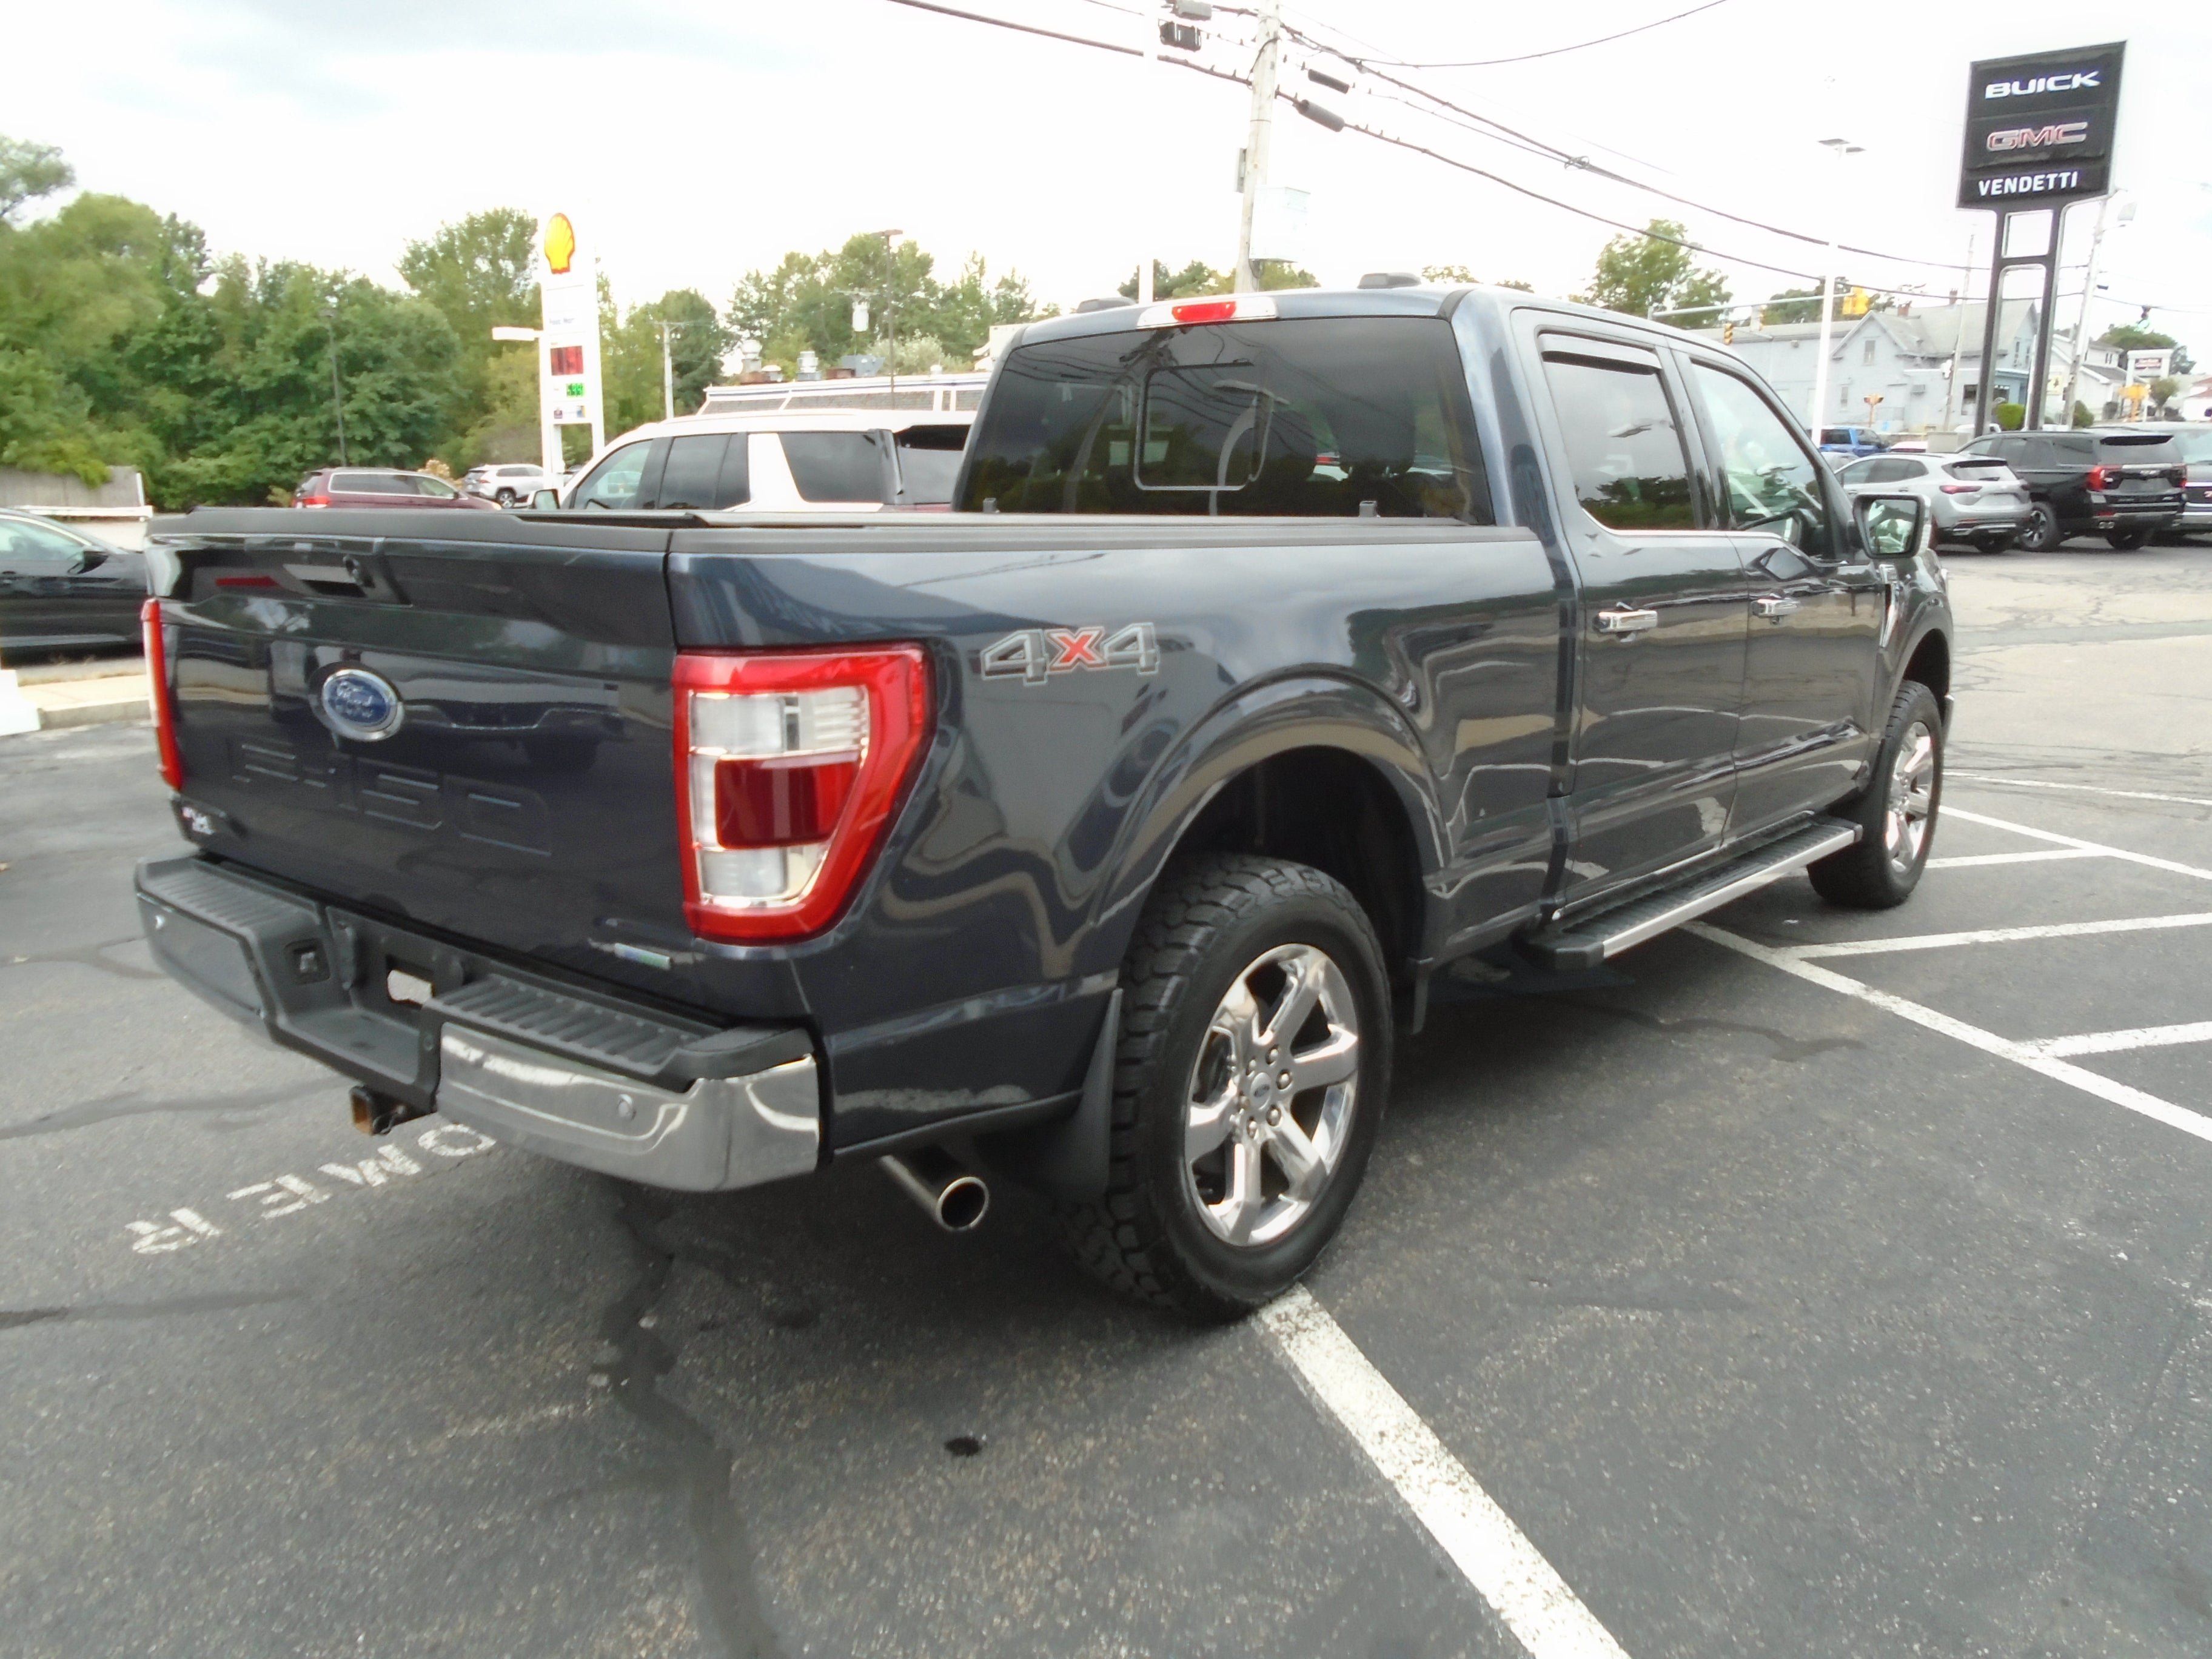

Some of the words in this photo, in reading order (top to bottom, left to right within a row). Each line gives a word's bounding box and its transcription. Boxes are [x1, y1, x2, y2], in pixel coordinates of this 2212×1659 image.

[1985, 71, 2100, 99] BUICK
[1986, 122, 2088, 152] GMC
[1978, 170, 2078, 196] VENDETTI
